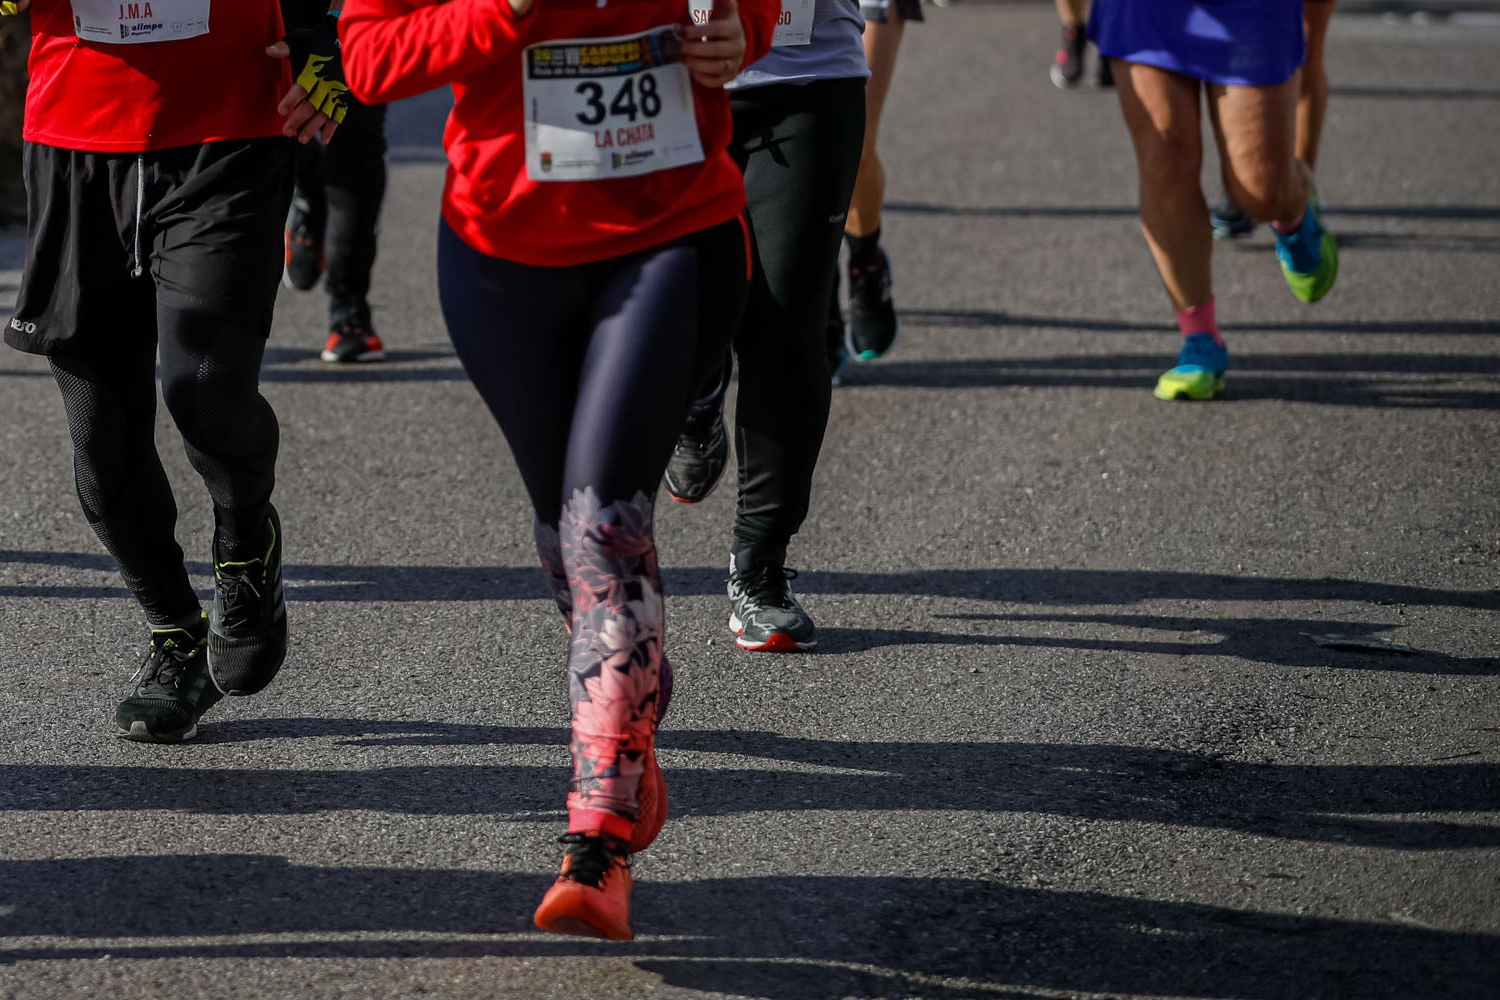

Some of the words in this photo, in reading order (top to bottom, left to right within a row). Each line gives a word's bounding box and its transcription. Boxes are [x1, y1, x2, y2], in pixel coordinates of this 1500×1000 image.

[118, 2, 153, 20] J.M.A
[131, 23, 163, 31] olimpo
[575, 72, 661, 125] 348
[595, 129, 613, 148] LA
